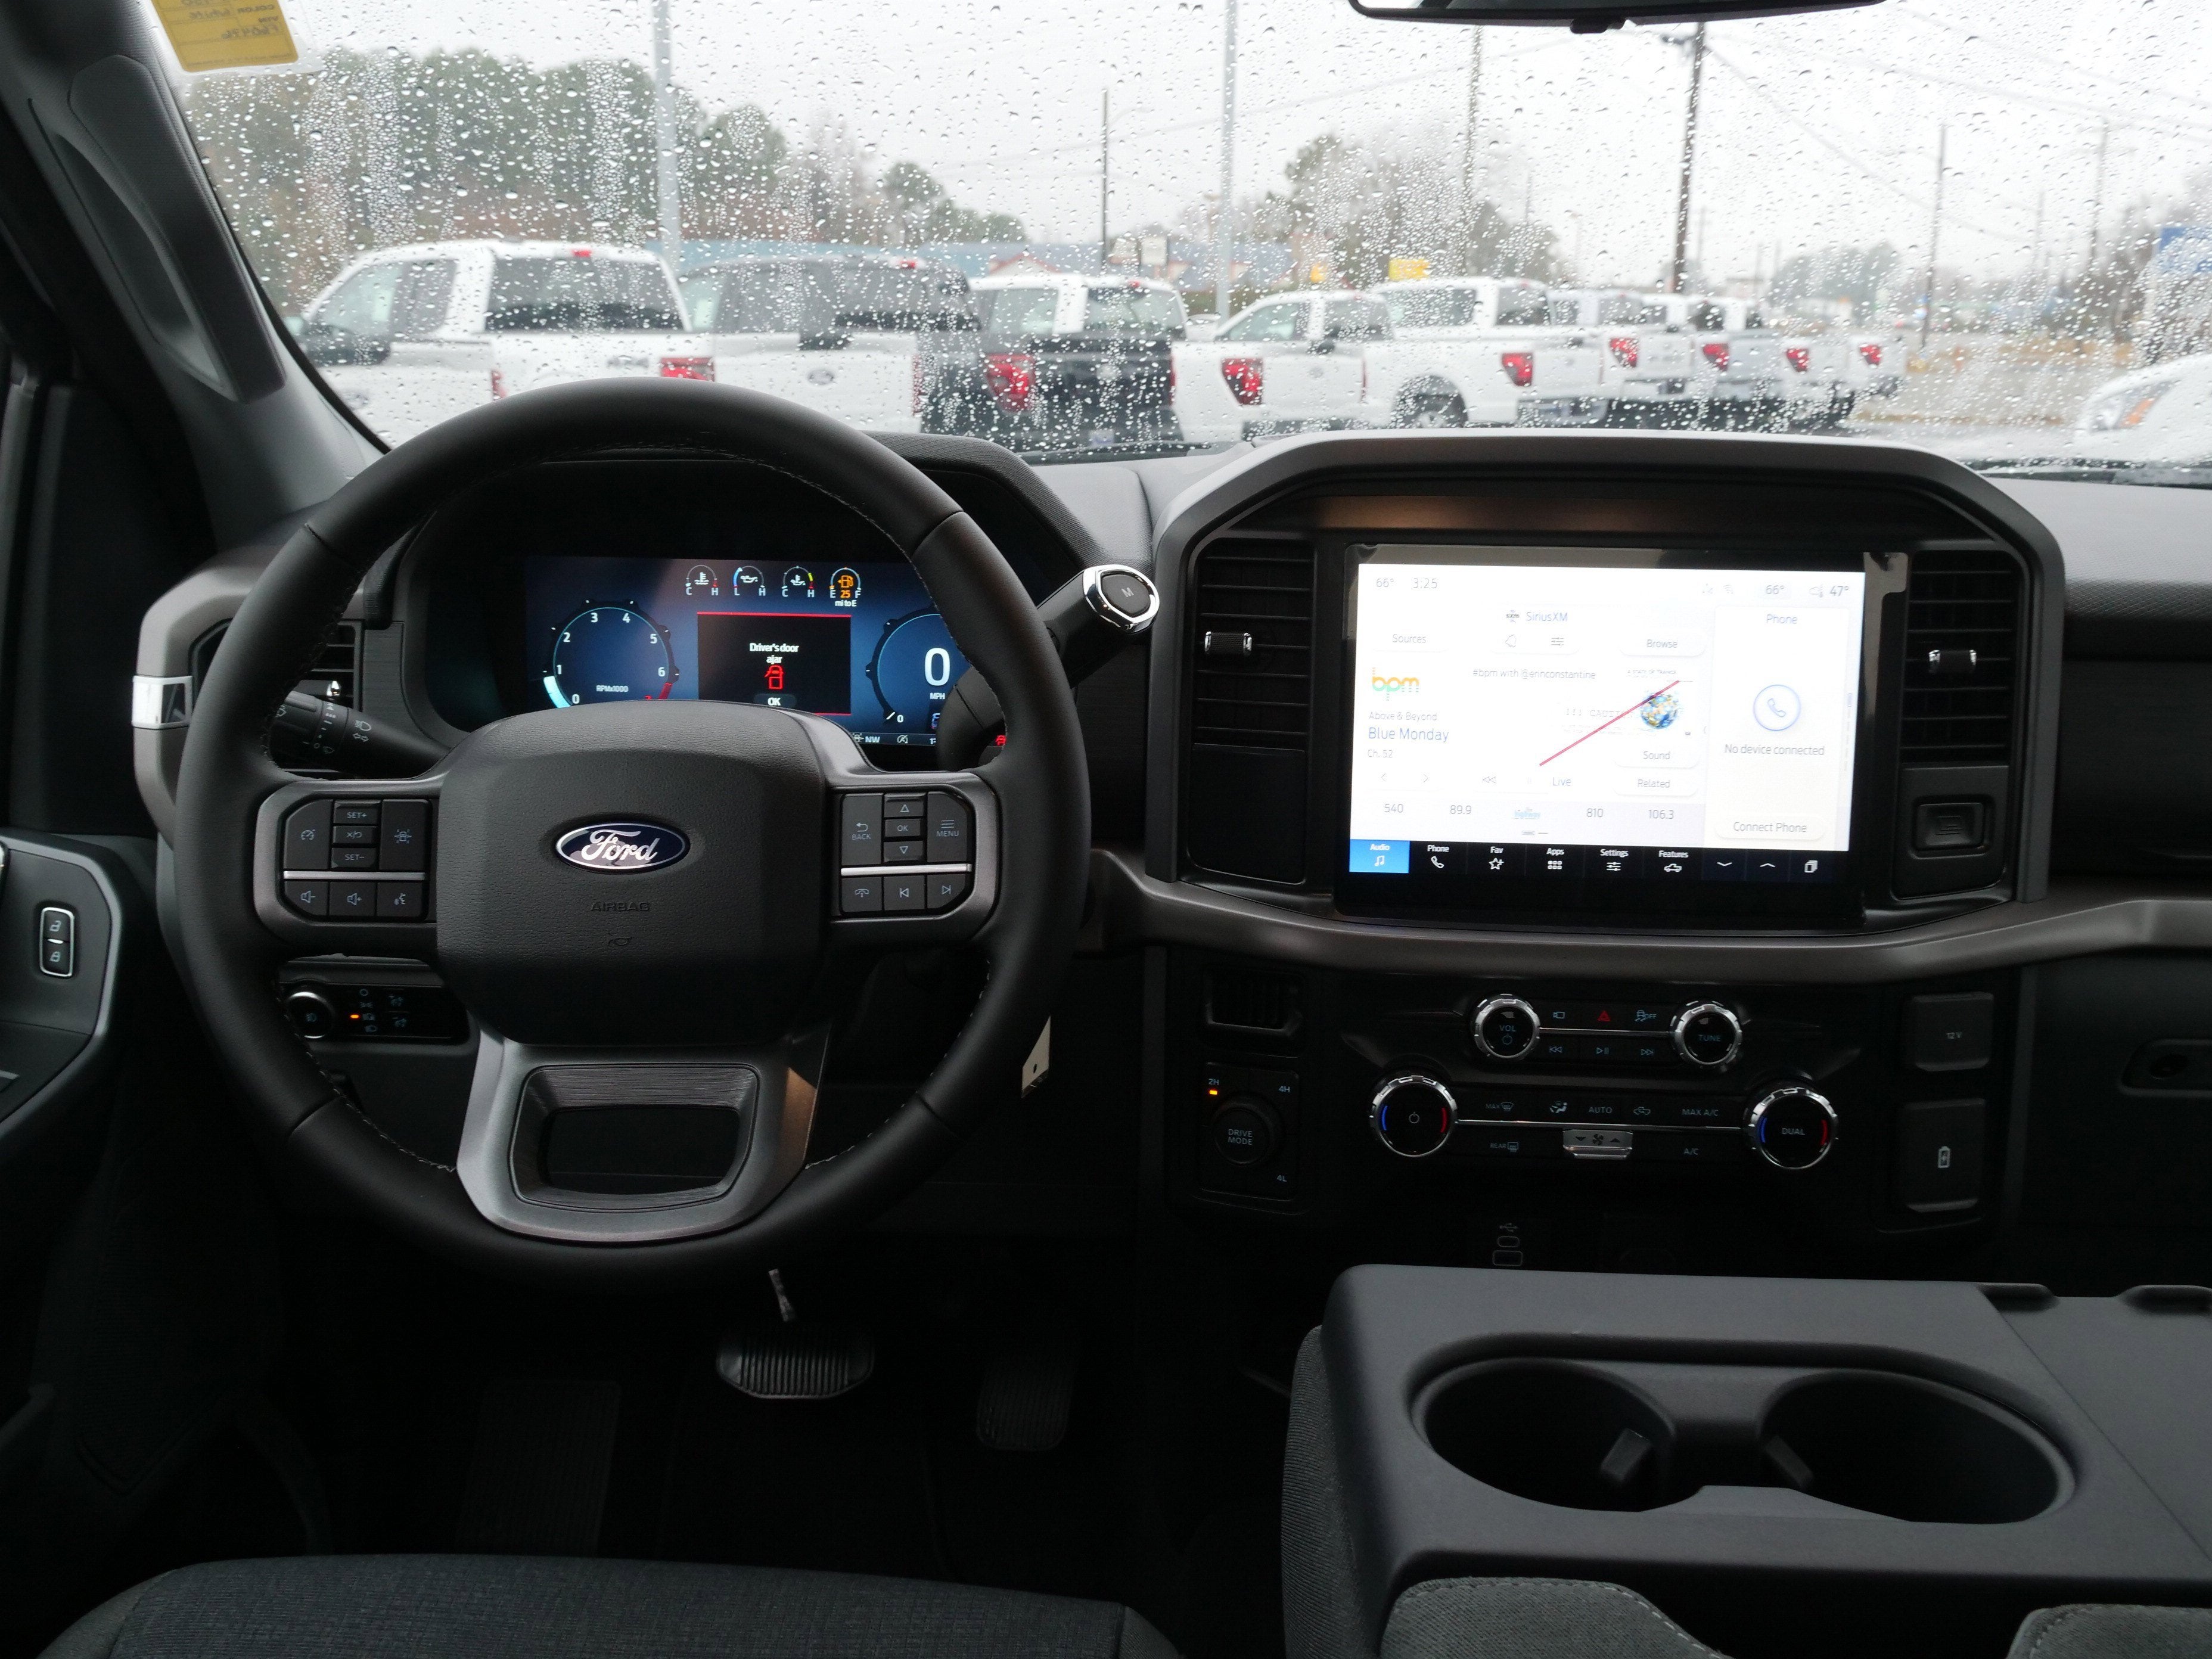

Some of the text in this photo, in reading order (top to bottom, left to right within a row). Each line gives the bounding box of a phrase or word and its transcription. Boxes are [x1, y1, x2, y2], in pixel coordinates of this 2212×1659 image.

[1412, 577, 1438, 589] 3:25
[685, 586, 692, 595] C
[711, 587, 719, 596] H
[734, 587, 740, 596] L
[758, 588, 766, 597] H
[781, 588, 788, 597] C
[807, 589, 815, 598] H
[830, 589, 836, 598] E
[840, 589, 851, 598] 25
[855, 590, 861, 599] F
[1766, 585, 1785, 595] 66°
[1829, 585, 1850, 597] 47°
[590, 612, 598, 623] 3
[622, 613, 630, 623] 4
[1526, 611, 1568, 622] SiriusXM
[1766, 614, 1798, 624] Phone
[563, 632, 570, 642] 2
[650, 633, 657, 644] 5
[1392, 633, 1427, 644] Sources
[749, 642, 799, 653] Driver's door
[1646, 639, 1678, 648] Browse
[766, 654, 783, 664] ajar
[557, 664, 562, 675] 1
[924, 647, 950, 686] 0
[657, 666, 666, 677] 6
[1500, 669, 1519, 678] with
[571, 694, 580, 704] 0
[767, 697, 781, 706] OK
[896, 714, 904, 723] 0
[1369, 712, 1395, 720] Above
[1406, 712, 1437, 722] Beyond
[1369, 727, 1449, 743] Blue Monday
[1382, 750, 1393, 758] 52
[1724, 744, 1825, 756] No device connected
[1642, 751, 1670, 760] Sound
[1552, 777, 1572, 787] Live
[1637, 779, 1670, 788] Related
[1383, 803, 1404, 813] 540
[1449, 804, 1472, 815] 89.9
[1586, 808, 1604, 818] 810
[1648, 809, 1674, 819] 106.3
[1733, 821, 1808, 833] Connect Phone
[580, 828, 661, 861] Ford
[1369, 843, 1390, 851] Audio
[1427, 844, 1450, 853] Phone
[1490, 846, 1504, 854] Fav
[1546, 847, 1565, 856] Apps
[1599, 848, 1629, 858] Settings
[1658, 850, 1689, 859] Features
[589, 902, 651, 912] AIRBAG
[1697, 1034, 1722, 1042] TUNE
[1278, 1085, 1291, 1093] 4H
[1588, 1105, 1613, 1114] AUTO
[1681, 1108, 1719, 1117] MAX A/C
[1228, 1129, 1253, 1138] DRIVE
[1781, 1127, 1806, 1136] DUAL
[1228, 1136, 1253, 1145] MODE
[1683, 1147, 1700, 1156] A/C
[1276, 1174, 1287, 1183] 4L
